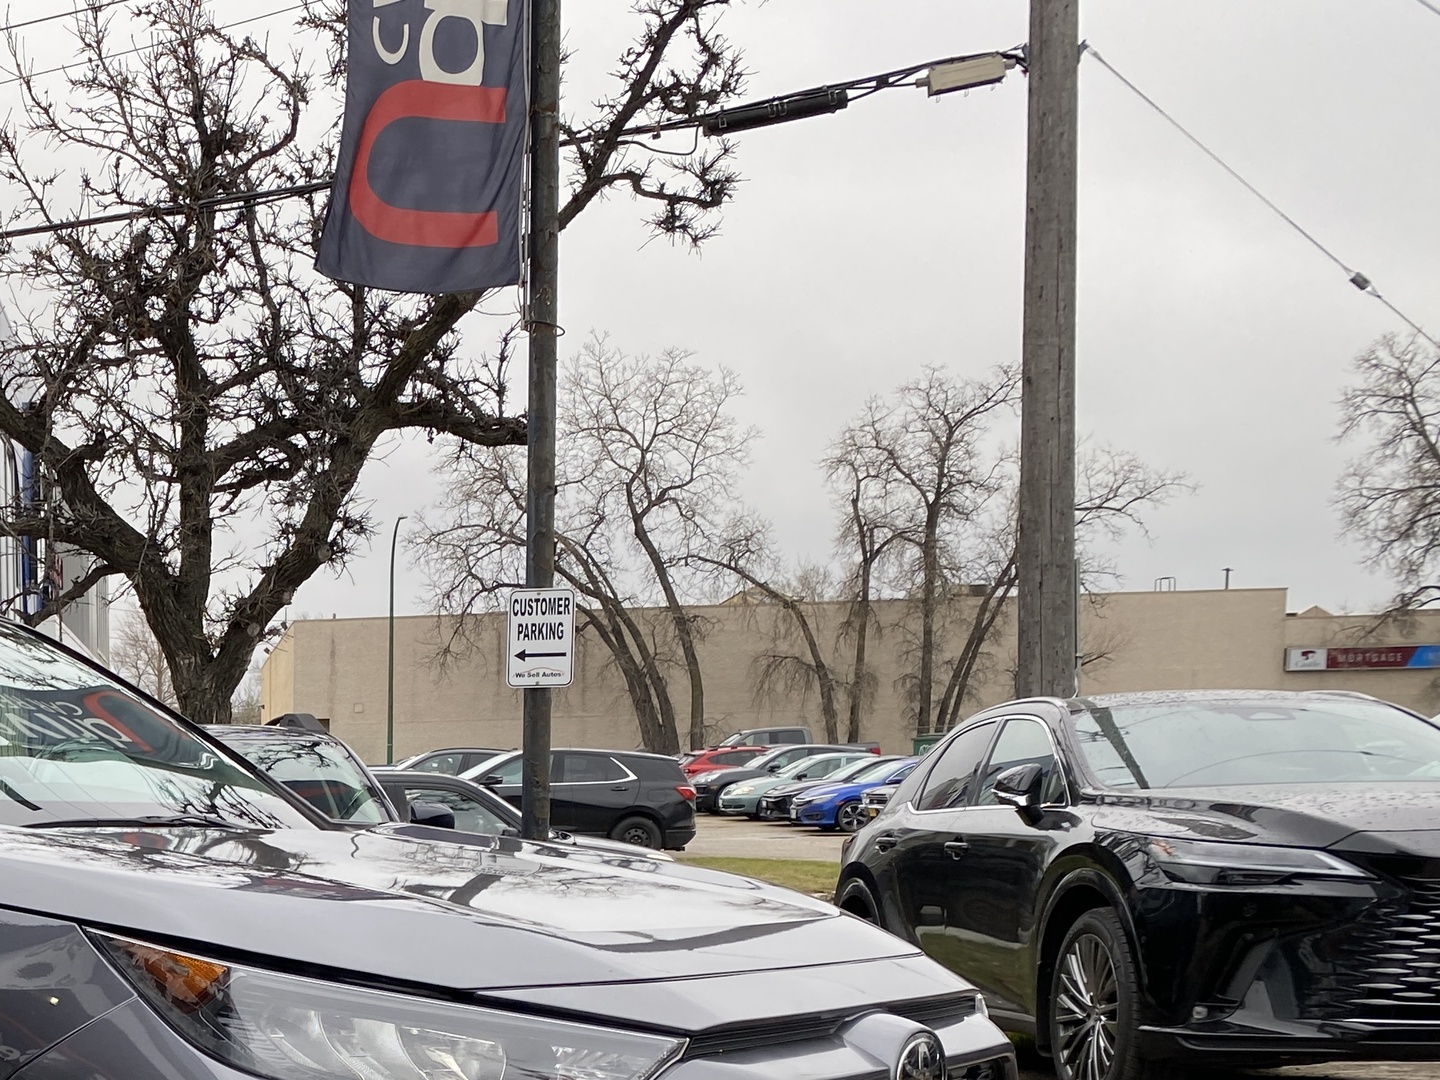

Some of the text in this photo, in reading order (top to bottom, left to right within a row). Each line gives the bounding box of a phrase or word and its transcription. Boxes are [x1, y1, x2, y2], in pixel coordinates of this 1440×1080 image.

[512, 597, 570, 616] CUSTOMER
[517, 622, 563, 640] PARKING
[1337, 652, 1403, 662] MORTGAGE
